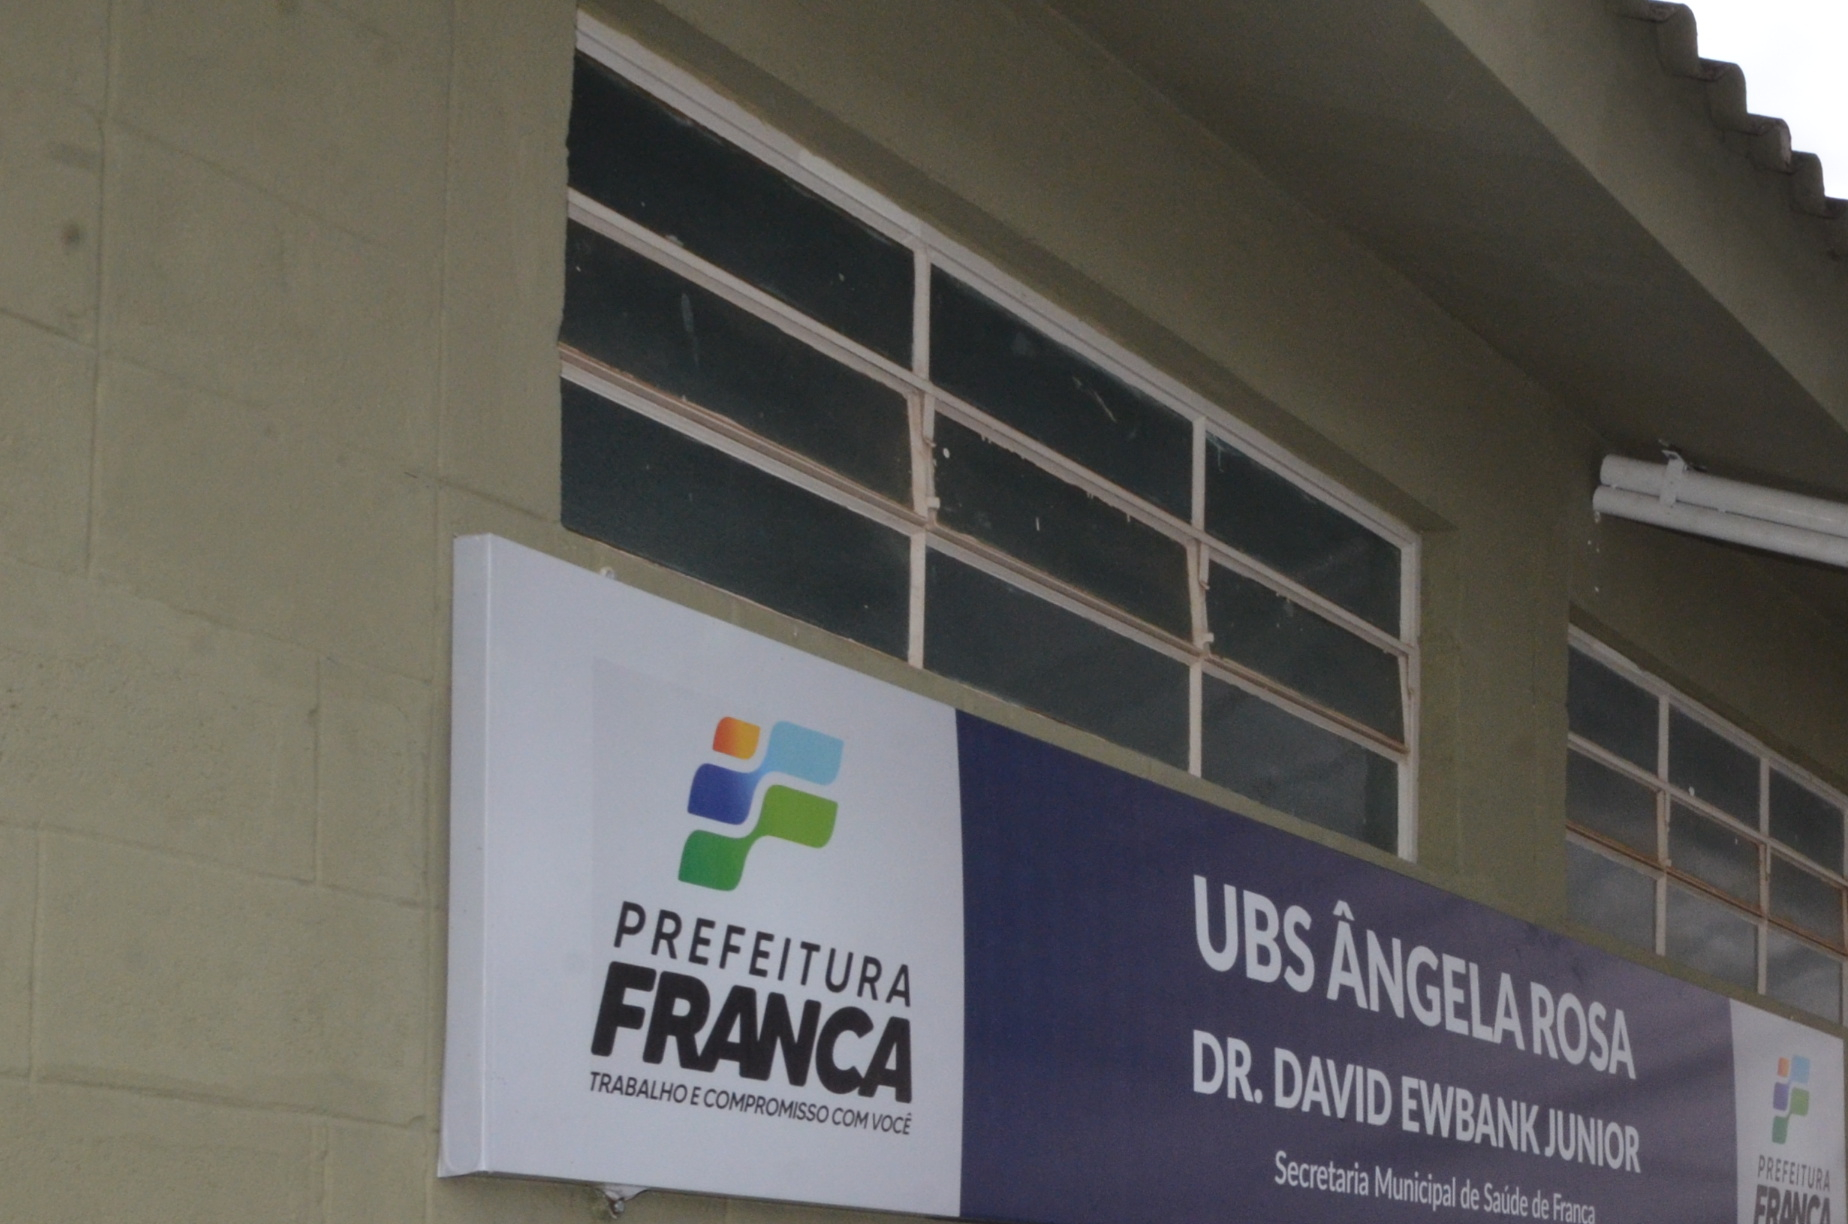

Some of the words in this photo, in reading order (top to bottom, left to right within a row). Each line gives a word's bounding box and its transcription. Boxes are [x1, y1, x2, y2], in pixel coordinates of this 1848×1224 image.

[613, 901, 912, 1008] PREFEITURA
[1193, 873, 1316, 993] UBS
[1326, 899, 1526, 1051] ÂNGELA
[1530, 981, 1637, 1080] ROSA
[590, 960, 913, 1104] FRANCA
[589, 1071, 688, 1104] TRABALHO
[690, 1085, 703, 1106] E
[703, 1088, 830, 1124] COMPROMISSO
[831, 1107, 870, 1130] COM
[872, 1111, 913, 1136] VOCÊ
[1193, 1028, 1264, 1104] DR.
[1274, 1046, 1393, 1126] DAVID
[1401, 1074, 1541, 1155] EWBANK
[1544, 1107, 1642, 1174] JUNIOR
[1274, 1150, 1370, 1196] Secretaria
[1374, 1165, 1457, 1212] Municipal
[1460, 1178, 1480, 1211] de
[1483, 1182, 1529, 1217] Saúde
[1531, 1189, 1550, 1220] de
[1757, 1154, 1831, 1192] PREFEITURA
